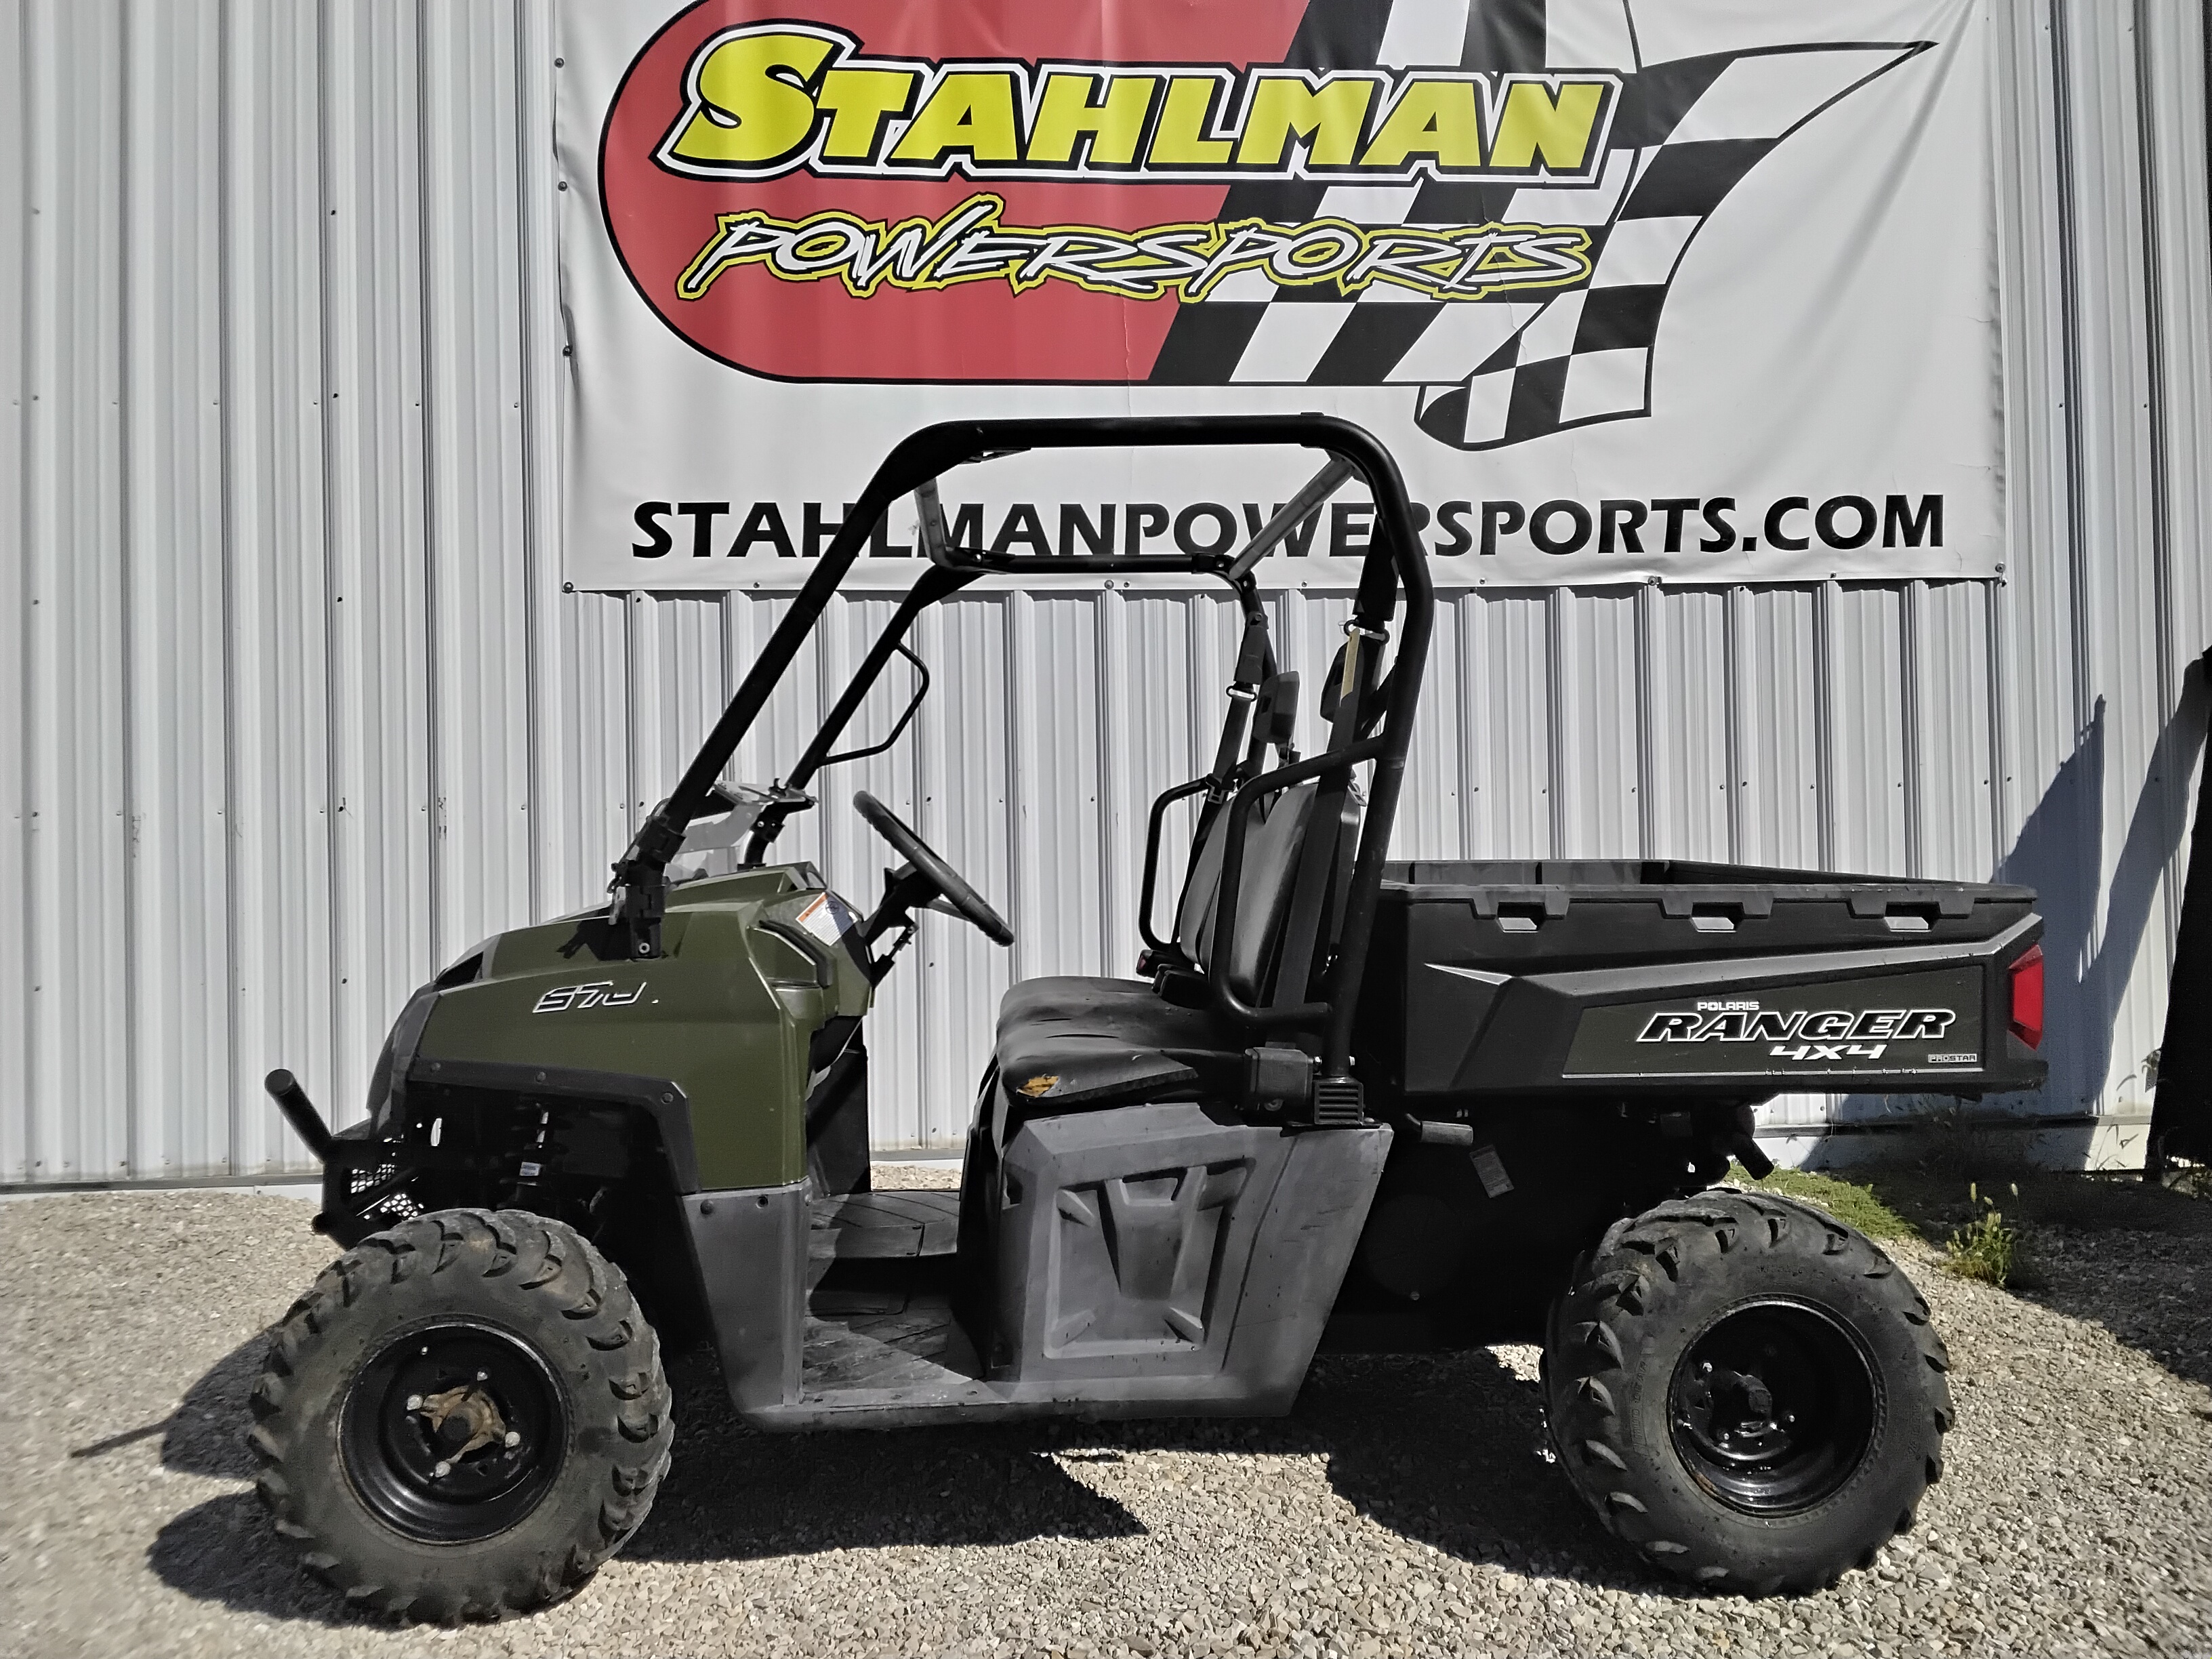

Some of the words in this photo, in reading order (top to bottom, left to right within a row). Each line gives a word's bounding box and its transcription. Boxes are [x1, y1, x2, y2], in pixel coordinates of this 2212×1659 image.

[655, 23, 1624, 183] STAHLMAN
[678, 195, 1590, 301] POWERSPORTS
[1637, 1008, 1956, 1042] RANGER
[1697, 1001, 1759, 1011] POLARIS
